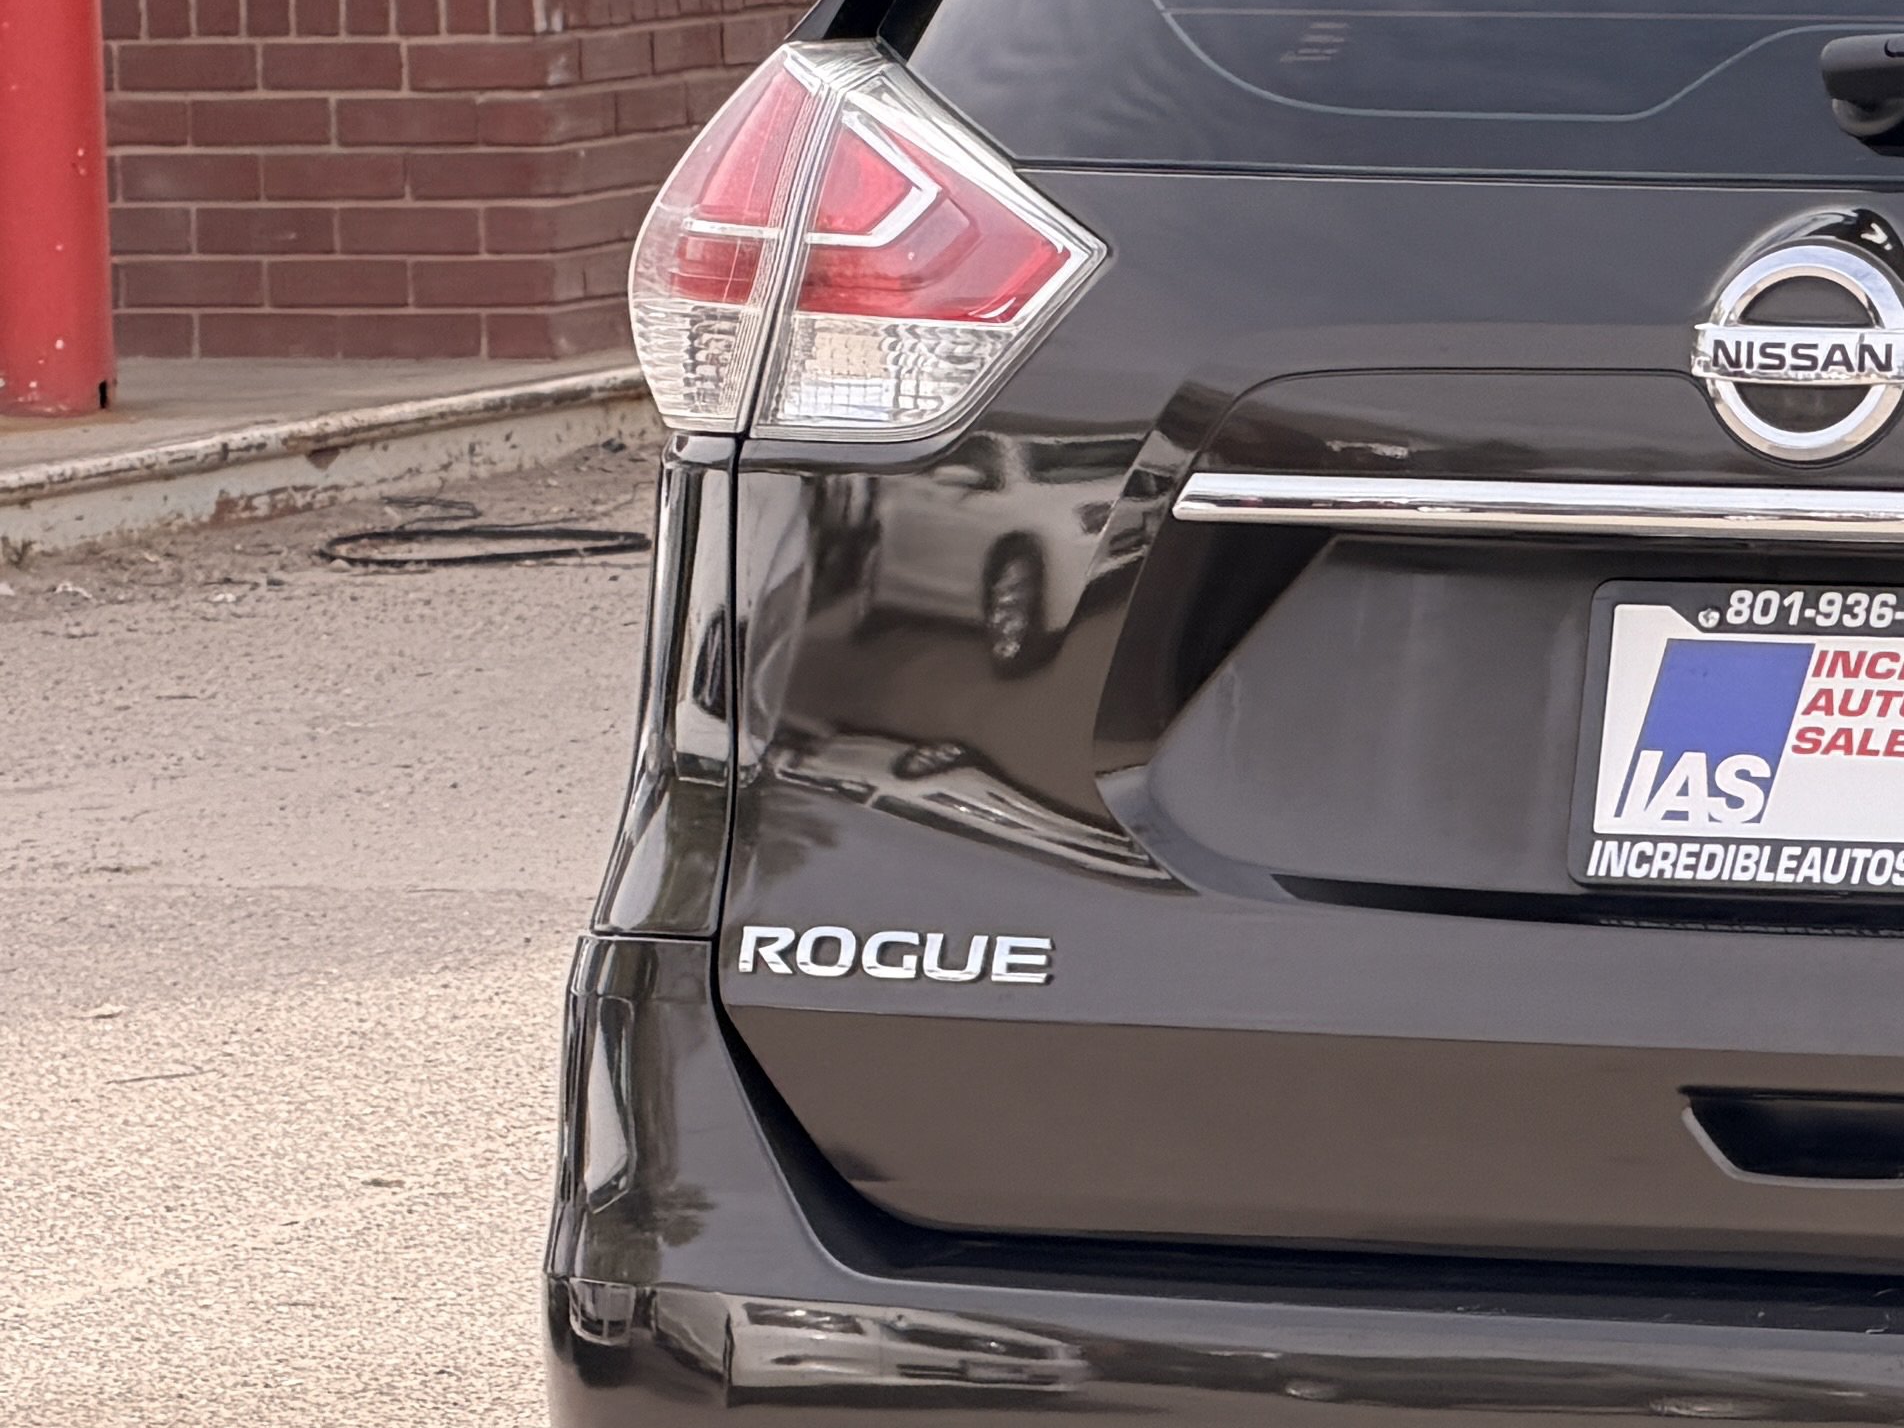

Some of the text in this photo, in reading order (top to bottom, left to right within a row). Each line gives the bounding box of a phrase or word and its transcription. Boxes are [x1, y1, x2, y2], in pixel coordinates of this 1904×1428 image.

[1711, 339, 1894, 373] NISSAN
[1621, 750, 1773, 823] IAS
[738, 925, 1054, 984] ROGUE
